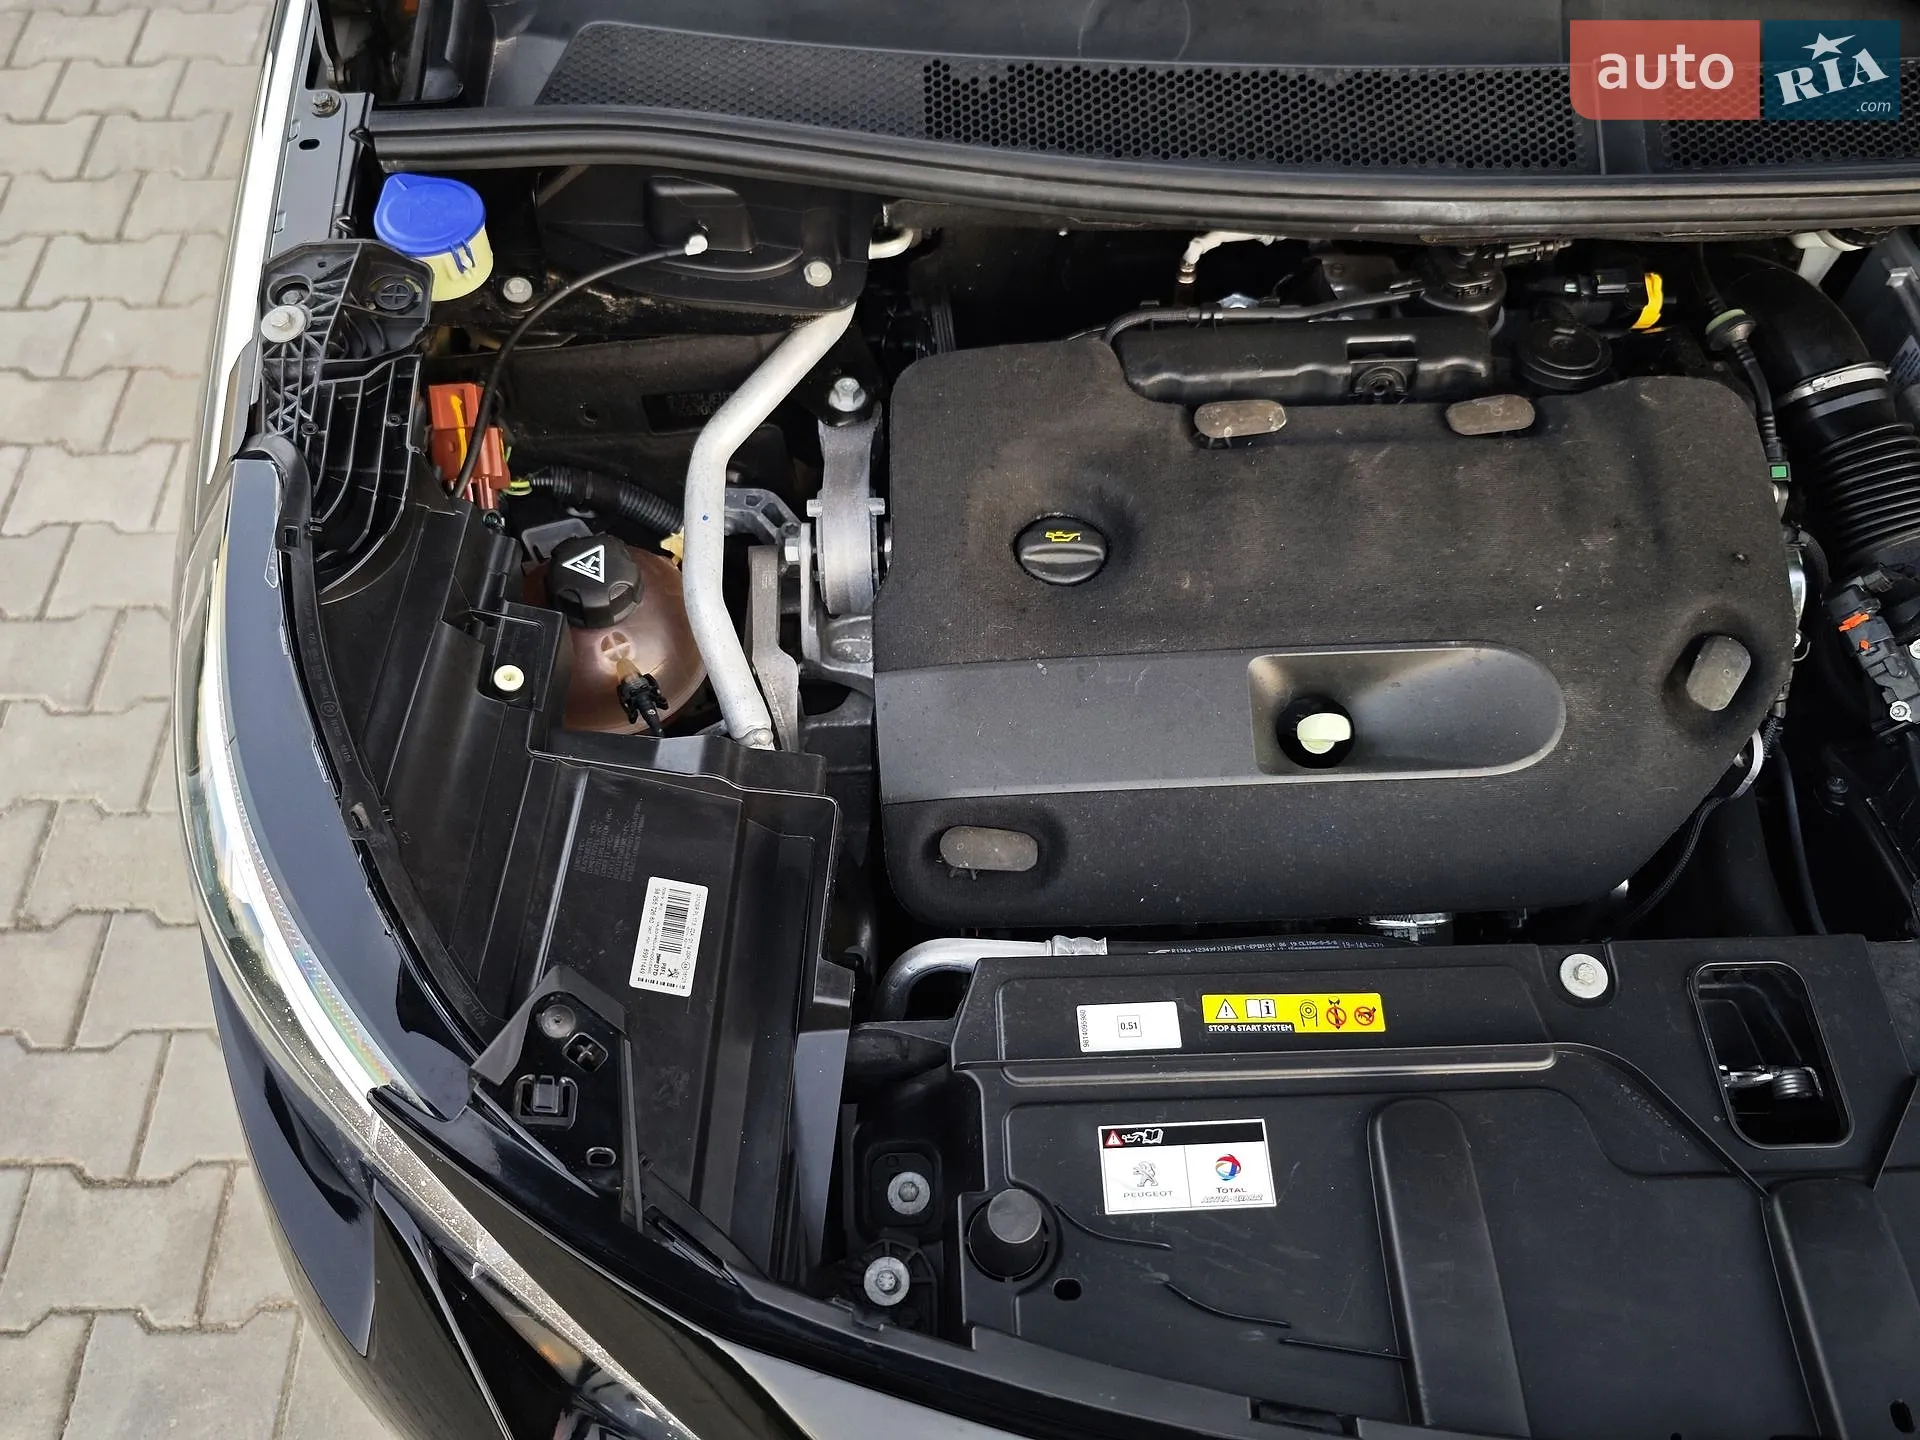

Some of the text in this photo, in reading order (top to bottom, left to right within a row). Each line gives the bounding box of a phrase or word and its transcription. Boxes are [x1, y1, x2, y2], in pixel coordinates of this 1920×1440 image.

[1120, 1022, 1138, 1031] 0.51
[1208, 1024, 1229, 1032] STOP
[1230, 1024, 1236, 1032] &
[1123, 1190, 1173, 1198] PEUGEOT
